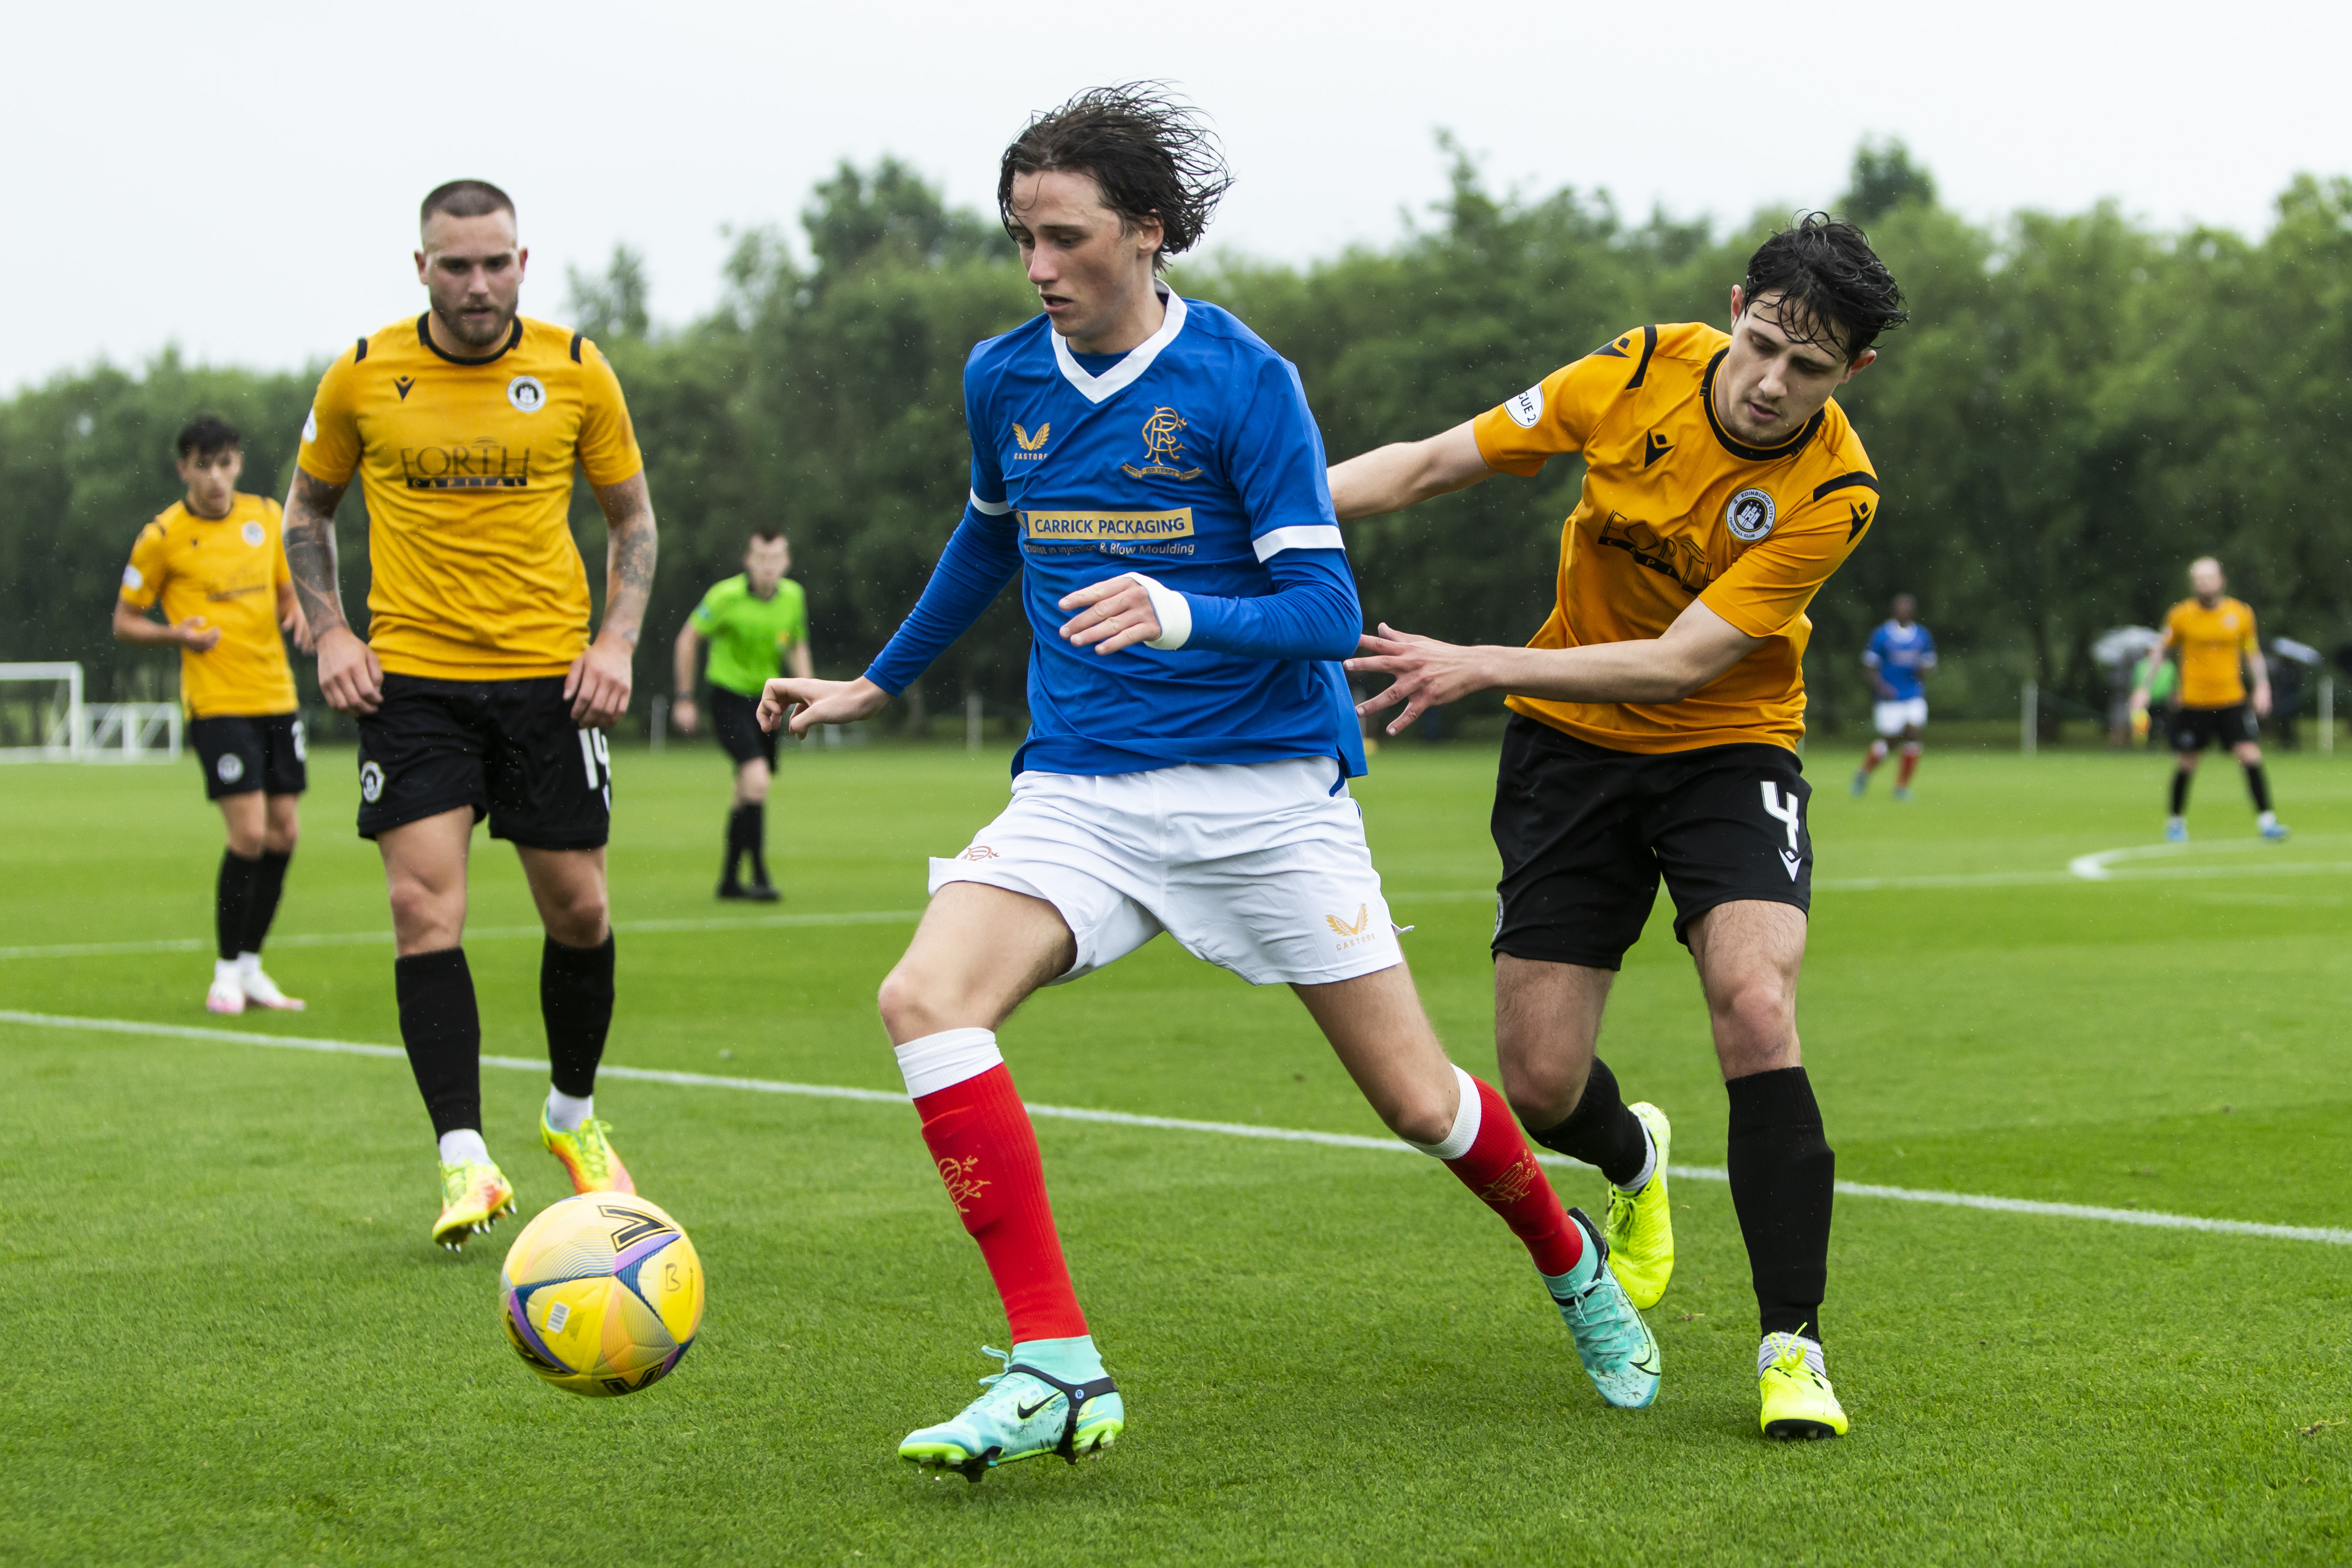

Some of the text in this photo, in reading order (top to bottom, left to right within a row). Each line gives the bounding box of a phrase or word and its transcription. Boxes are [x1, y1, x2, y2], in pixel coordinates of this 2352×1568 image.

[1527, 414, 1536, 423] 2
[400, 445, 530, 476] FORTH
[412, 478, 521, 487] CAPITAL
[1741, 491, 1771, 505] EDINBURGH
[1035, 517, 1185, 534] CARRICK PACKAGING
[1729, 517, 1742, 536] FOOTBALL
[1057, 544, 1097, 556] Injection
[1099, 542, 1108, 553] &
[1110, 542, 1136, 555] Blow
[1139, 543, 1194, 556] Moulding
[578, 727, 611, 790] 14
[1760, 781, 1799, 853] 4
[1336, 933, 1375, 951] CASTORE
[665, 1263, 681, 1292] B
